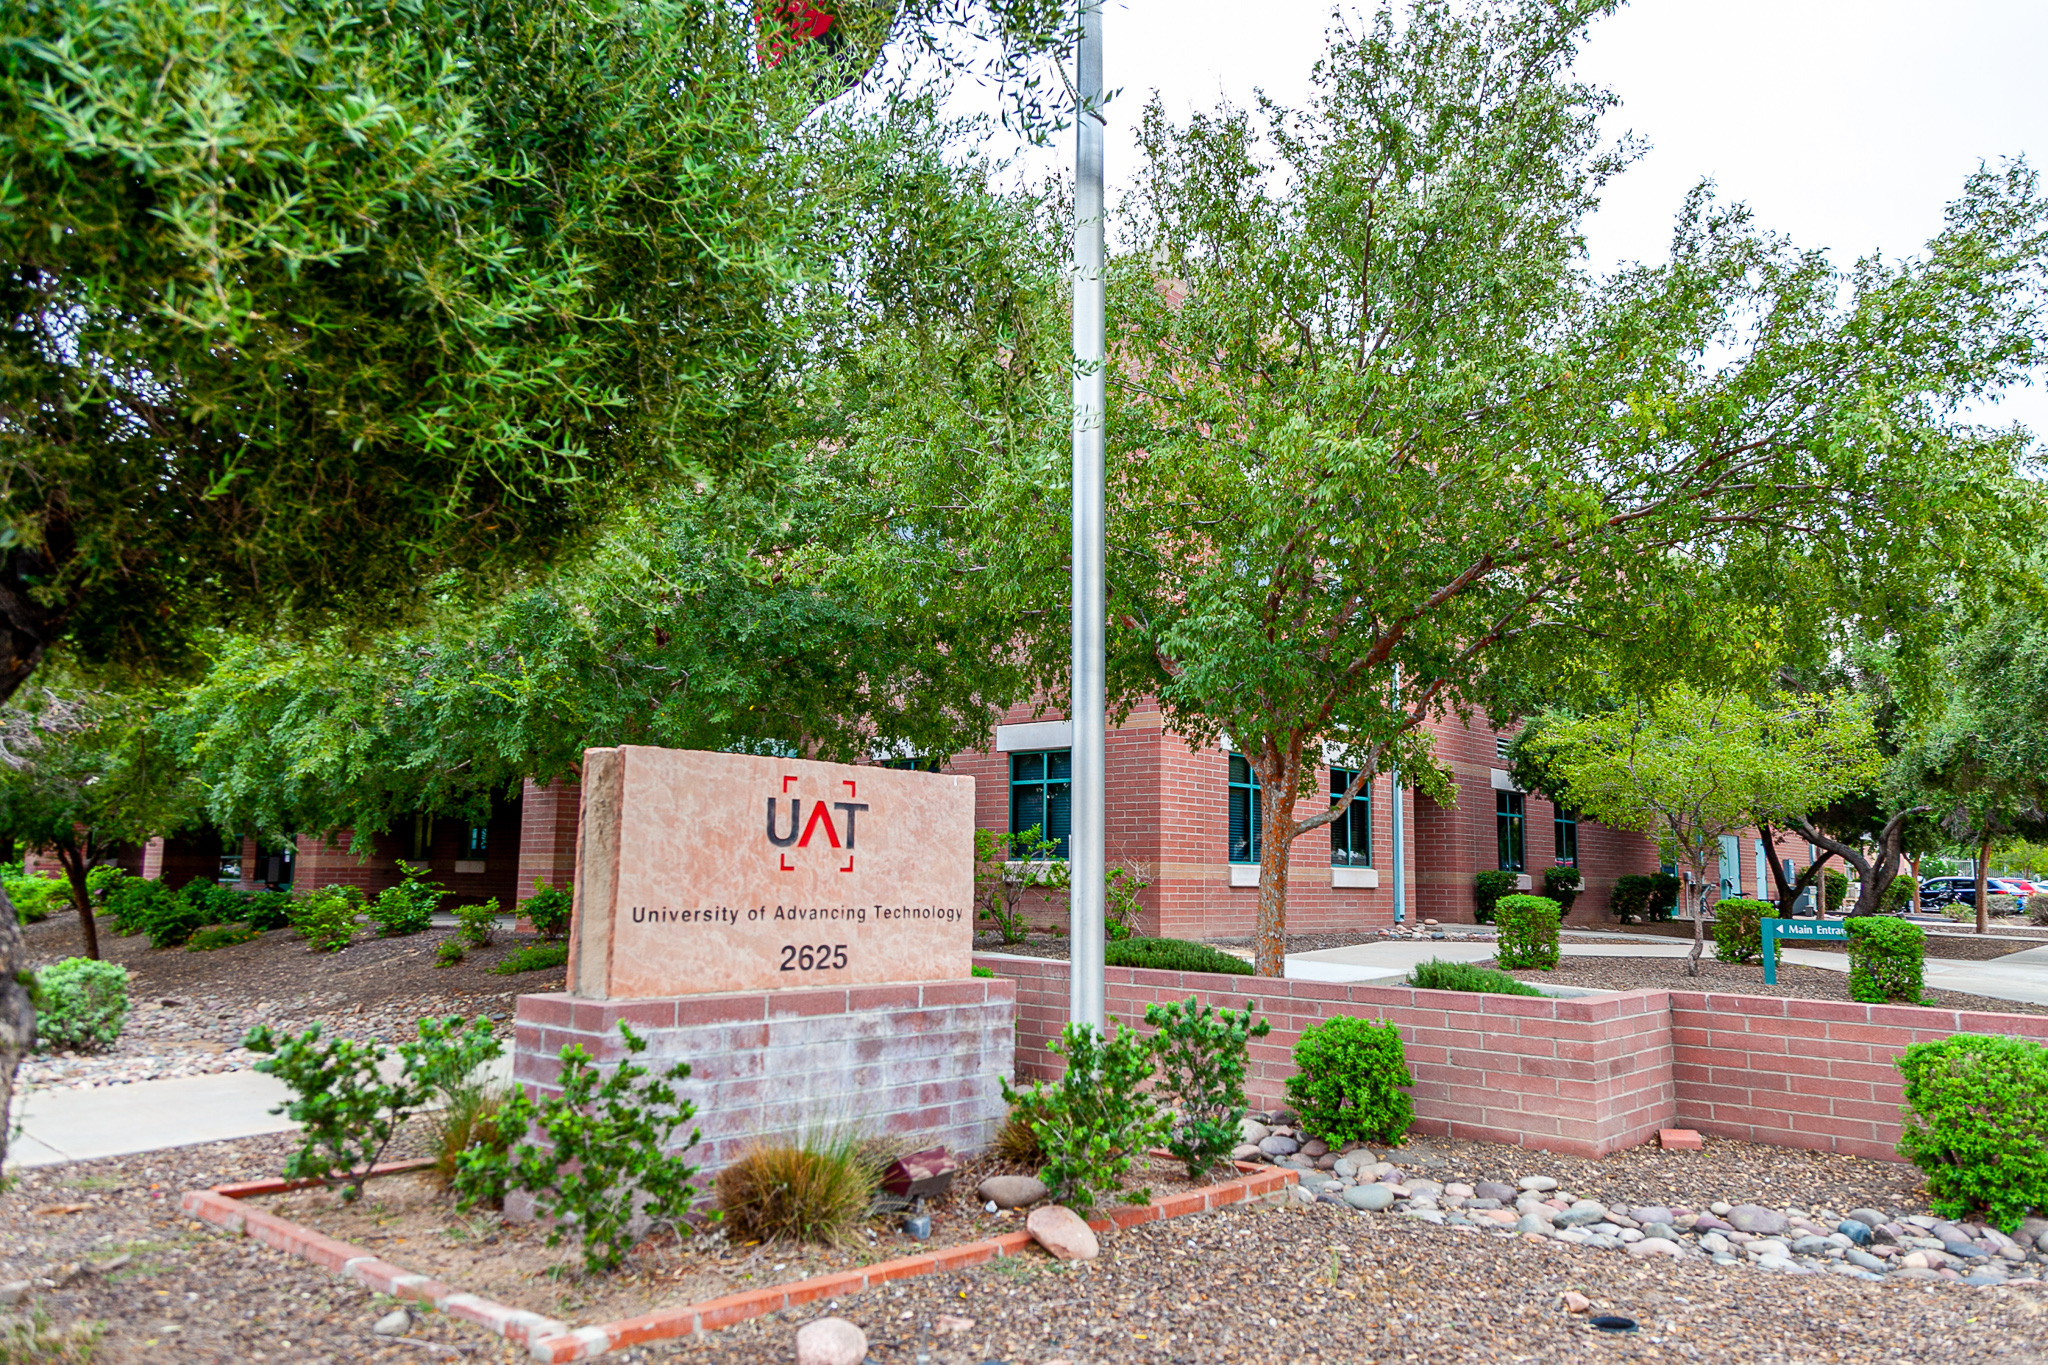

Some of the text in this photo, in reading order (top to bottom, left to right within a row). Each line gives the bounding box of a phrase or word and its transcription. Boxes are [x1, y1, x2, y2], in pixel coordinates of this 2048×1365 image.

[766, 797, 869, 850] UAT
[632, 905, 963, 925] University of Advancing Technology
[1788, 924, 1847, 935] Main Entran
[779, 944, 848, 972] 2625
